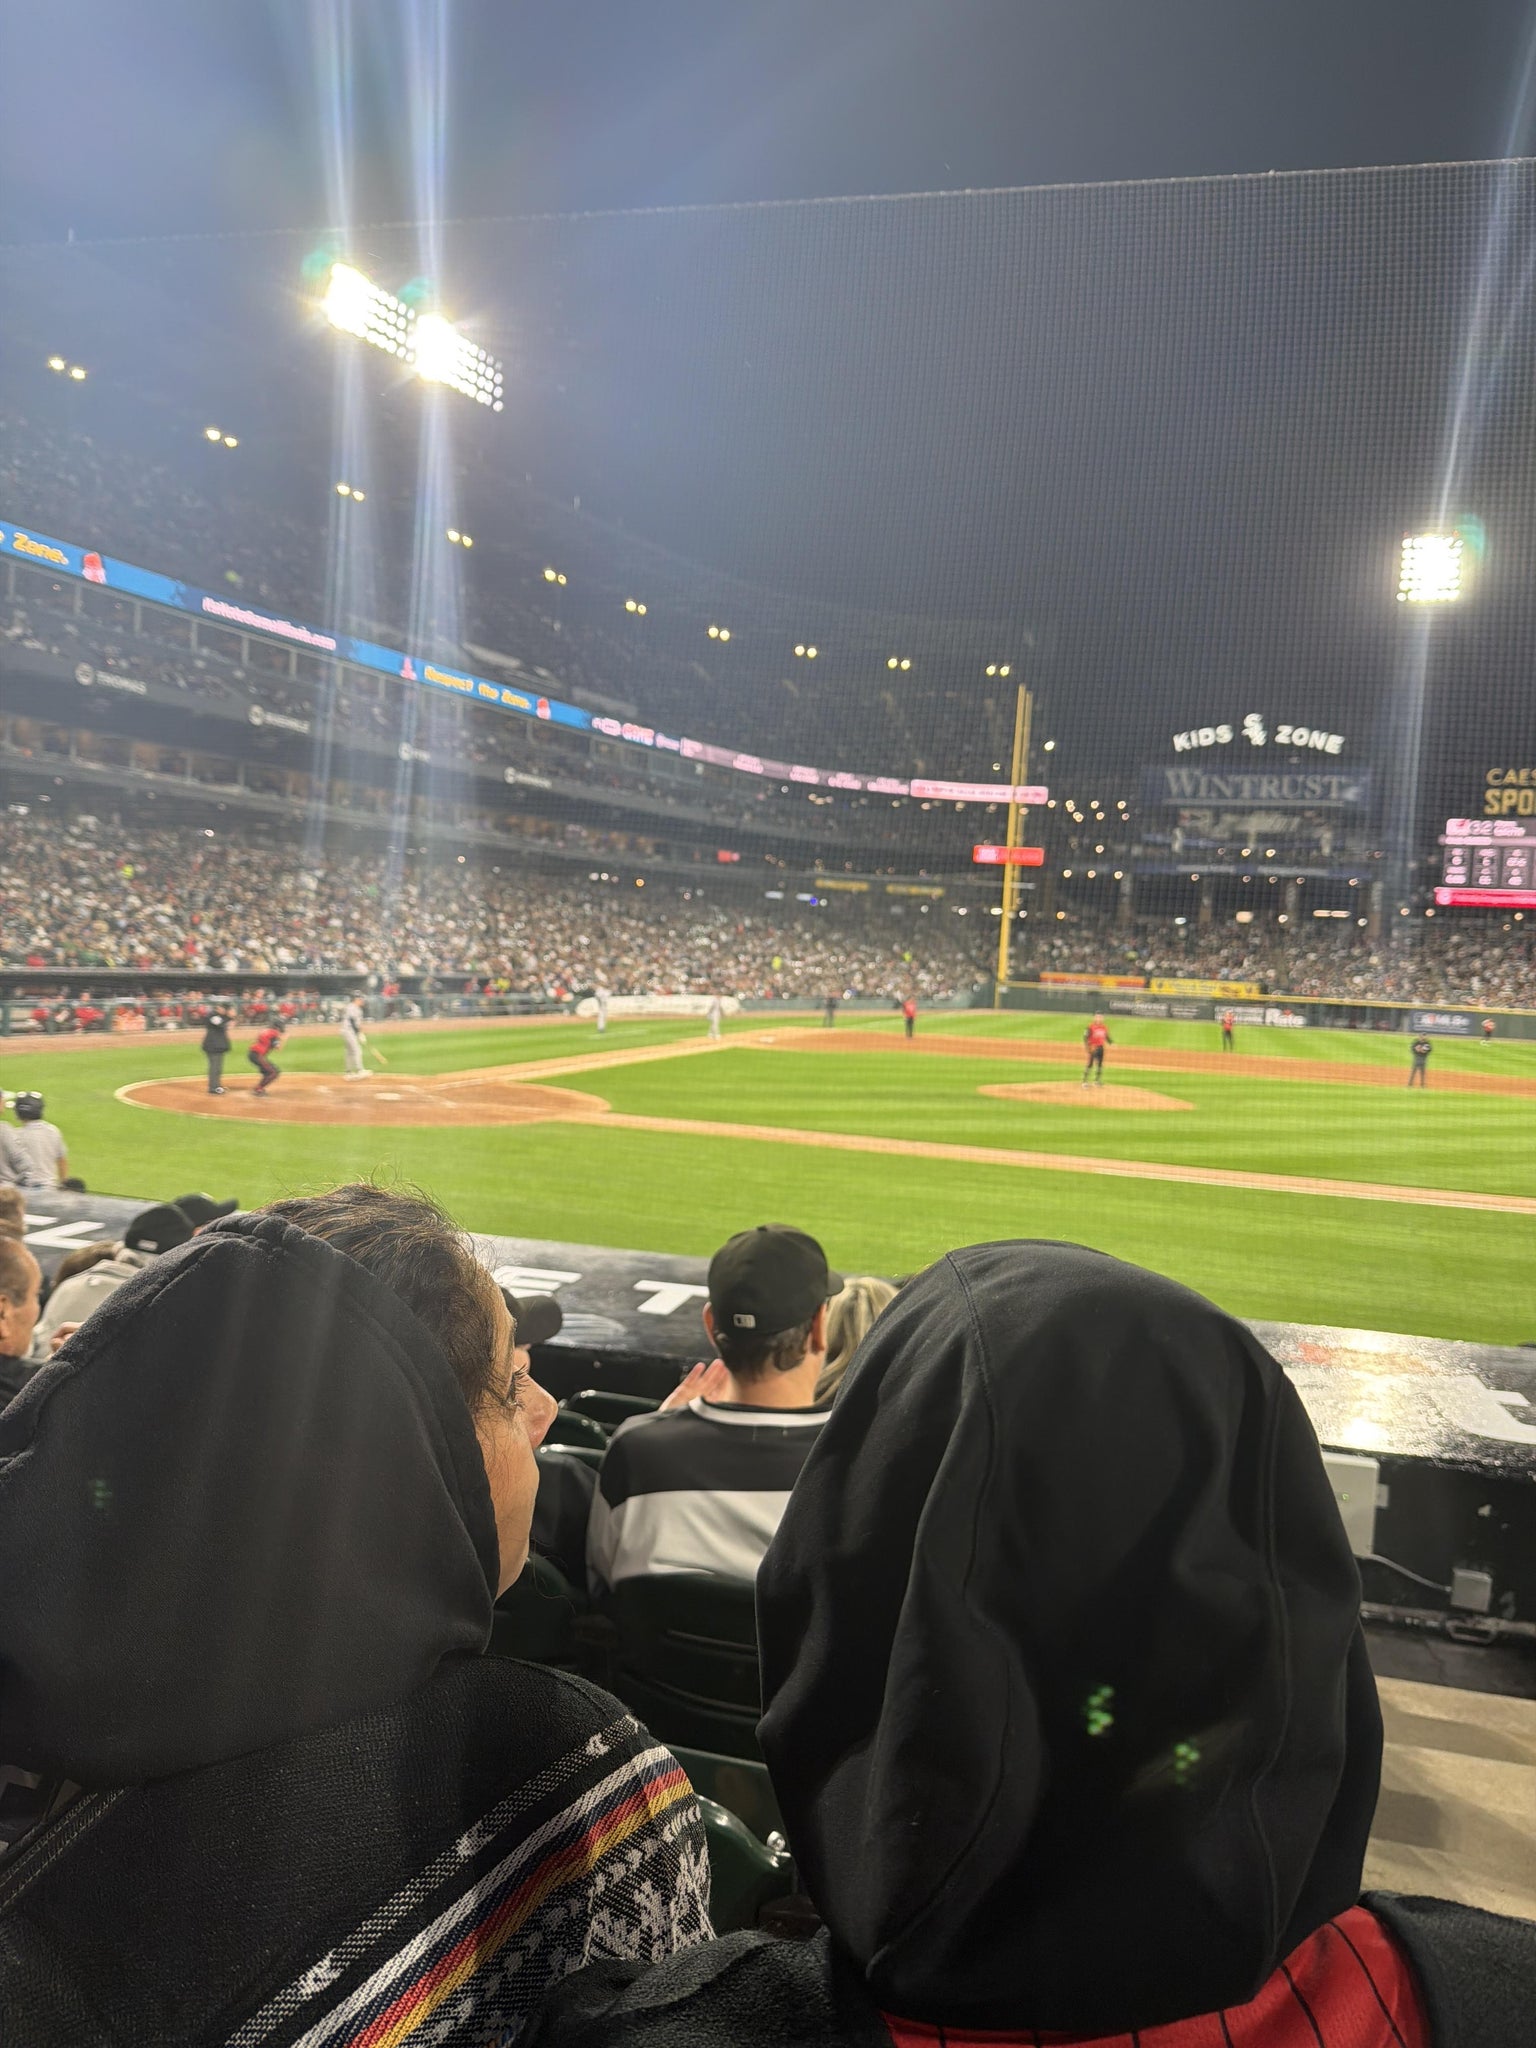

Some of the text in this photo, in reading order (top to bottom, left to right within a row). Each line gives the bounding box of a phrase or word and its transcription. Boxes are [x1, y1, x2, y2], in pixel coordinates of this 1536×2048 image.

[1173, 725, 1233, 752] KIDS
[1275, 725, 1345, 754] ZONE
[1165, 768, 1350, 800] WINTRUST
